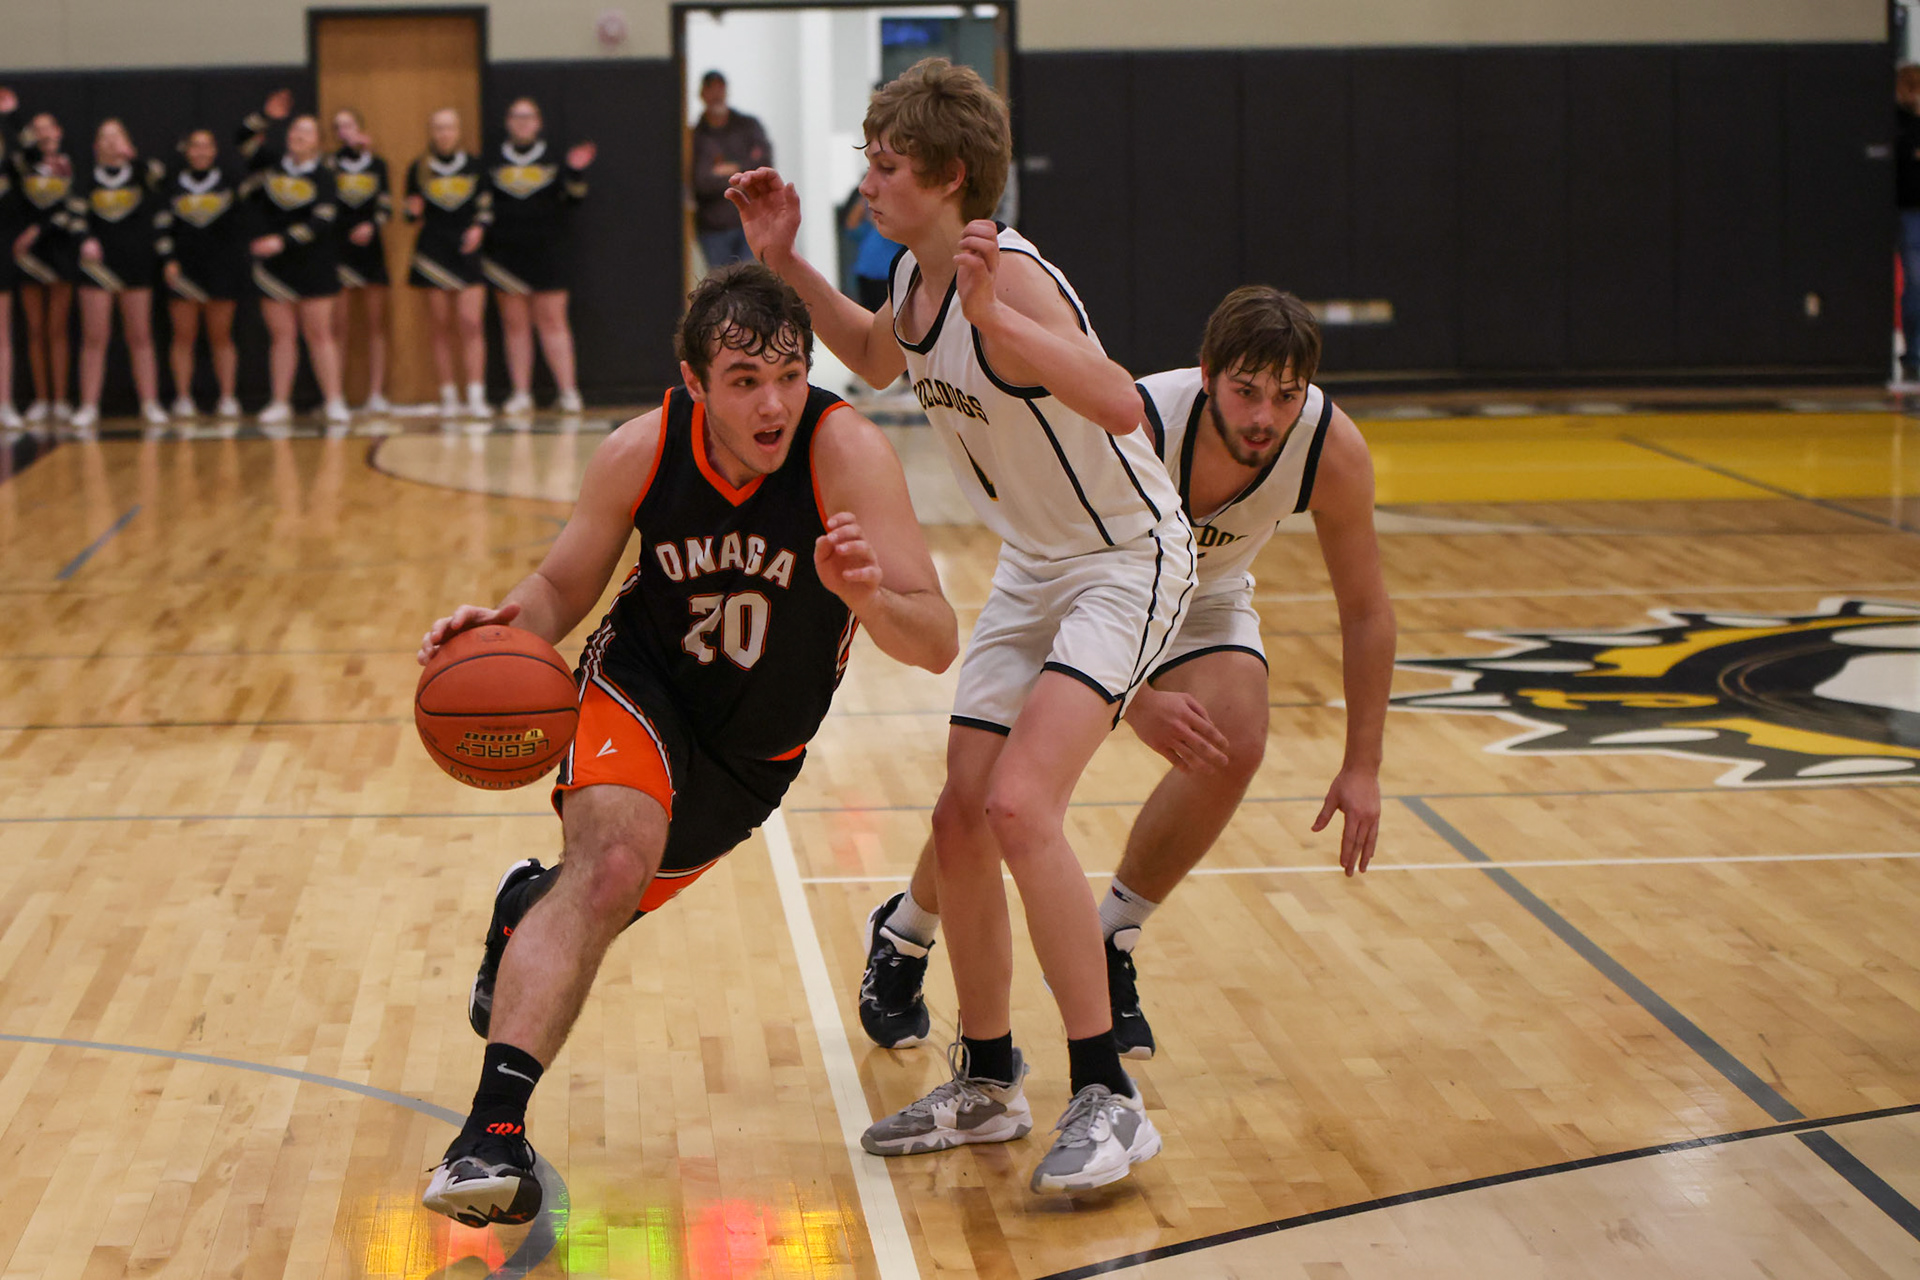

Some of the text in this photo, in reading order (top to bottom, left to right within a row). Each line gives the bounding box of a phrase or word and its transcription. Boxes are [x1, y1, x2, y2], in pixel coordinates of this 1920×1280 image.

[913, 378, 989, 425] ULLDOGS
[655, 530, 797, 589] ONAGA
[681, 590, 771, 671] 20
[456, 739, 549, 758] LEGACY
[465, 732, 522, 741] 1000
